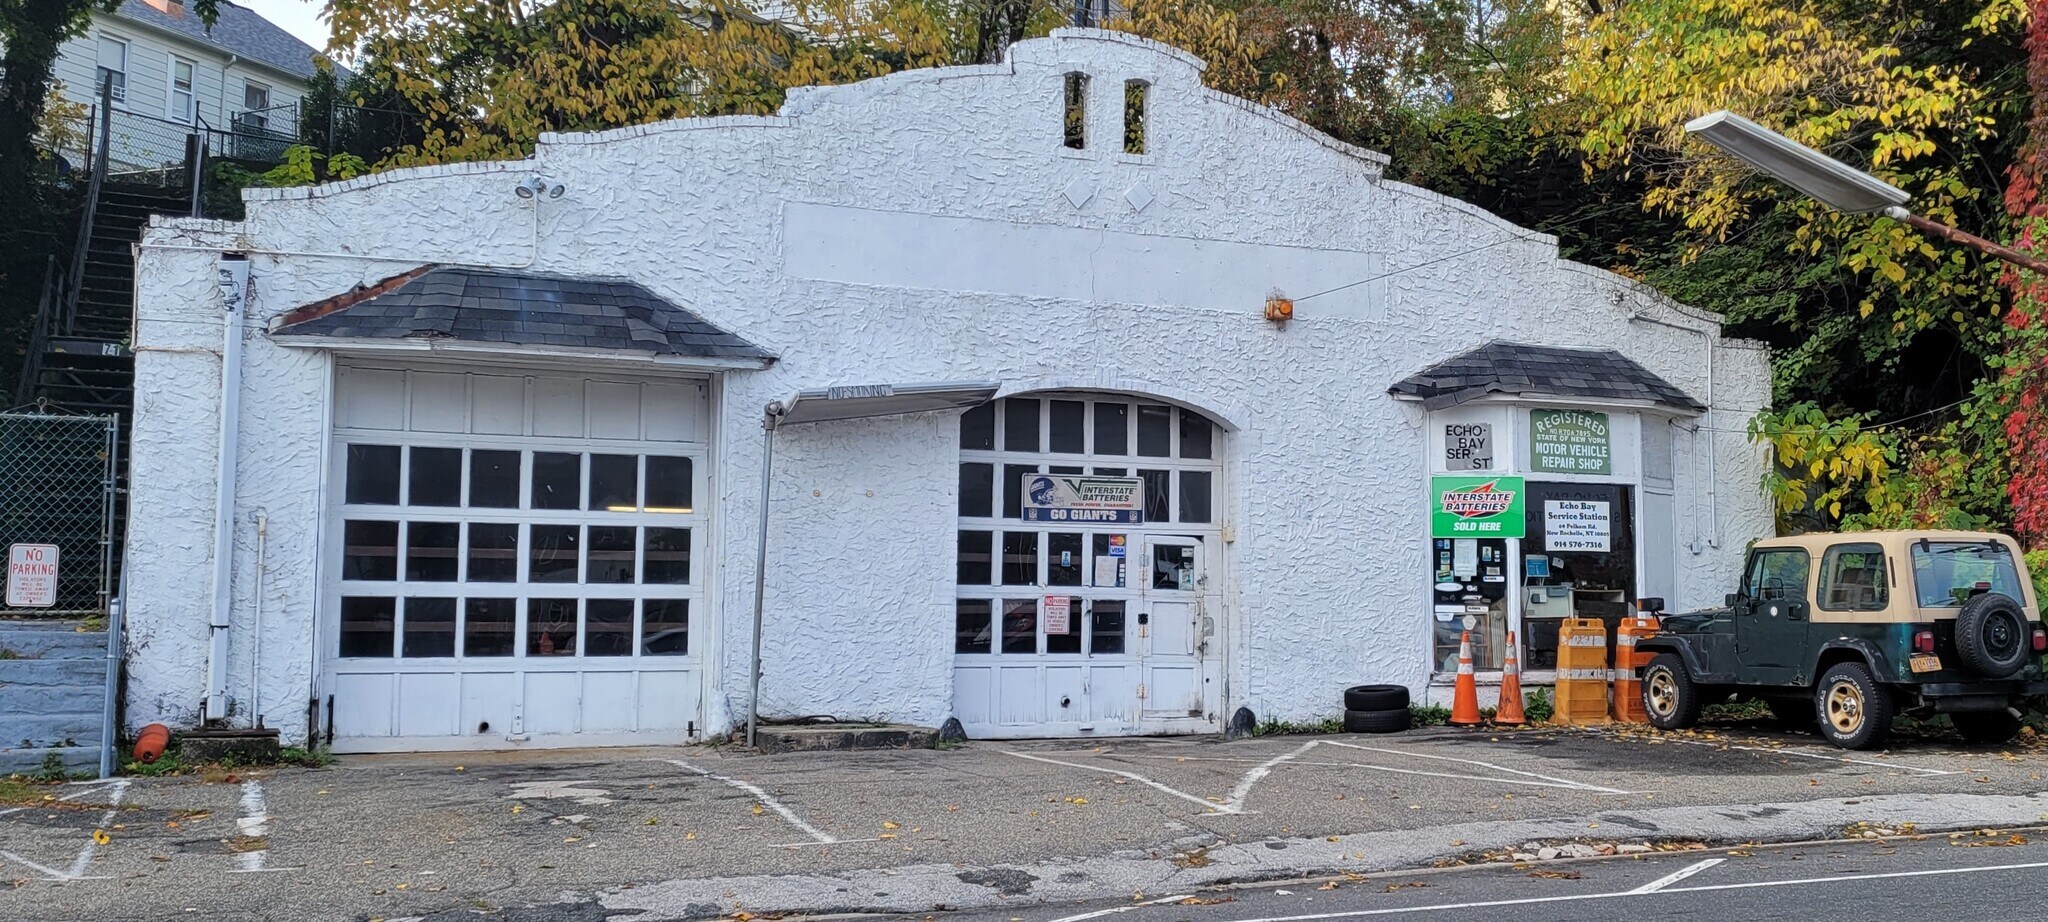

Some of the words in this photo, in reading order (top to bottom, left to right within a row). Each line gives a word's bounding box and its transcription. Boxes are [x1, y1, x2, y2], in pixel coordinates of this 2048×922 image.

[1535, 412, 1606, 436] REGISTERED
[1458, 437, 1486, 449] BAY
[1588, 437, 1607, 445] YORK
[1535, 442, 1567, 455] MOTOR
[1570, 444, 1608, 458] VEHICLE
[1542, 456, 1576, 469] REPAIR
[1578, 458, 1604, 470] SHOP
[1083, 486, 1134, 495] INTERSTATE
[1082, 494, 1130, 502] BATTERIES
[1444, 493, 1511, 501] INTERSTATE
[1446, 503, 1506, 511] BATTERIES
[1559, 502, 1579, 510] Echo
[1580, 502, 1597, 511] Bay
[1050, 509, 1068, 520] GO
[1070, 509, 1117, 521] GIANTS
[1548, 512, 1578, 520] Service
[1579, 512, 1608, 520] Station
[1453, 522, 1477, 531] SOLD
[1478, 522, 1502, 531] HERE
[25, 550, 43, 561] NO
[12, 563, 54, 575] PARKING
